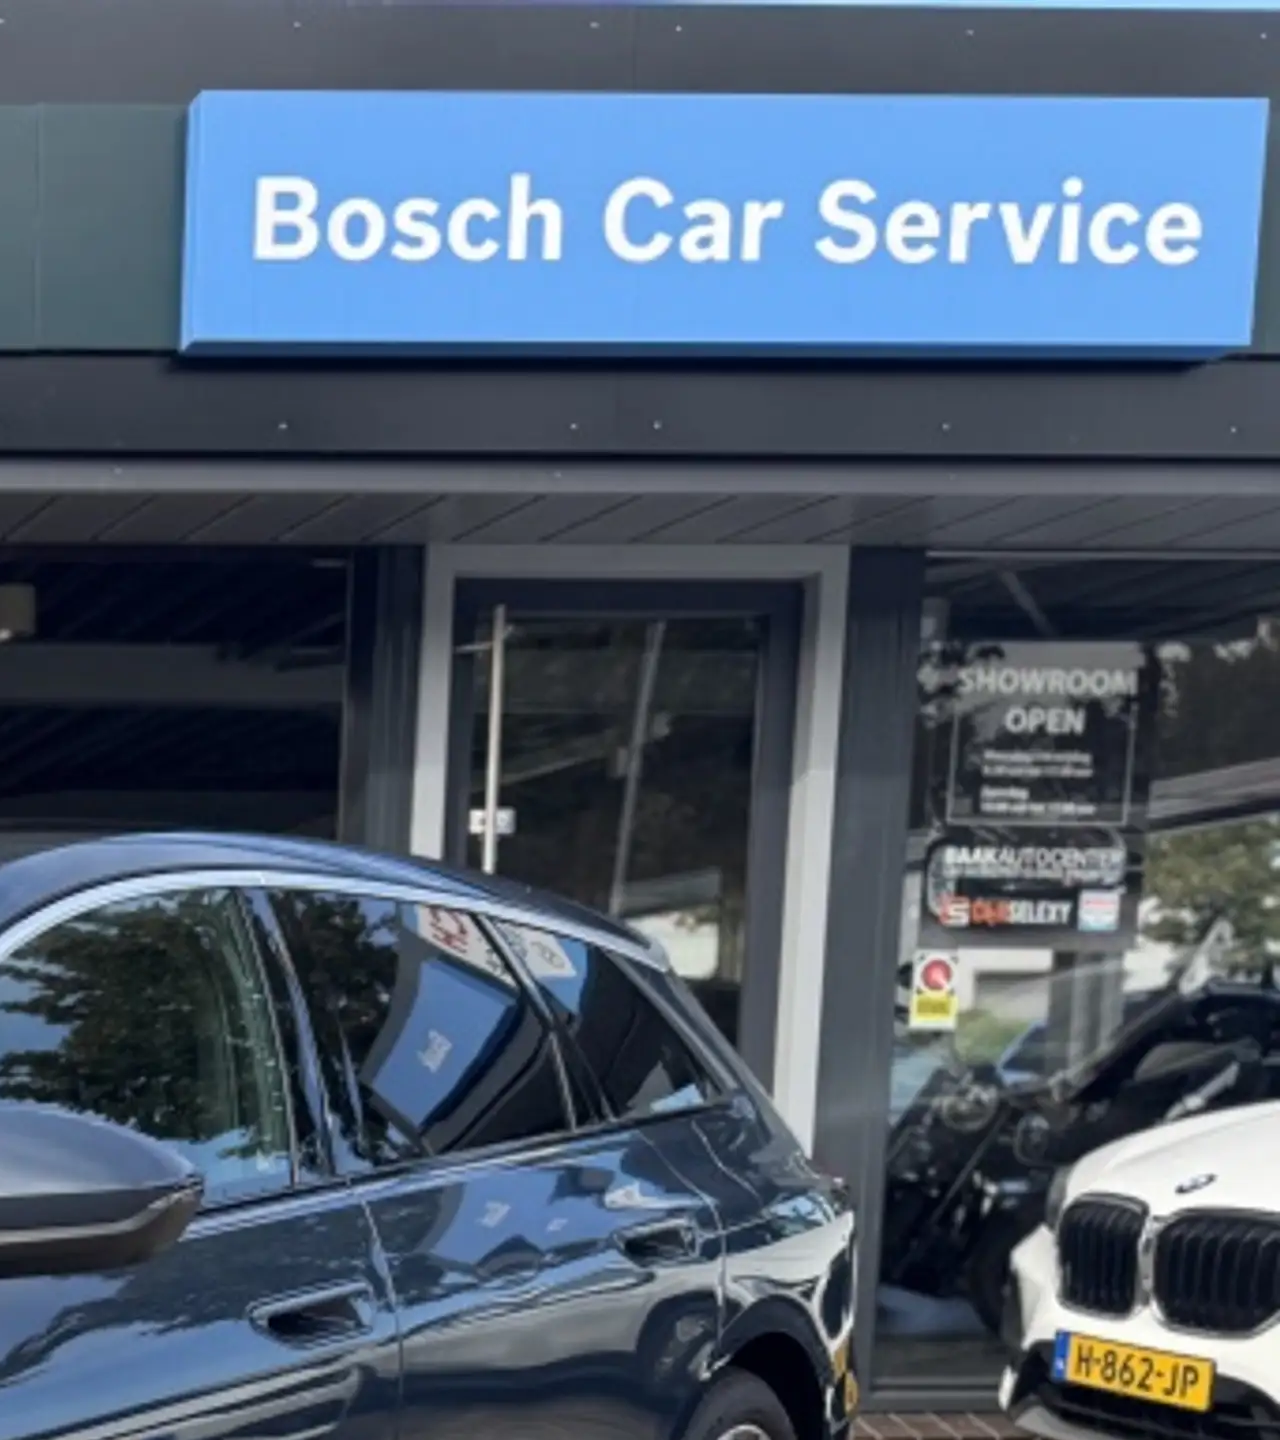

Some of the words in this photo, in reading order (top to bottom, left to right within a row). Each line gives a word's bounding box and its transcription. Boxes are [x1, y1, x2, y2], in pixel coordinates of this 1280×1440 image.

[254, 173, 564, 263] Bosch
[604, 177, 785, 264] Car
[815, 177, 1204, 266] Service
[957, 667, 1138, 696] SHOWROOM
[1004, 707, 1086, 734] OPEN
[1074, 1343, 1200, 1399] H-862-JP
